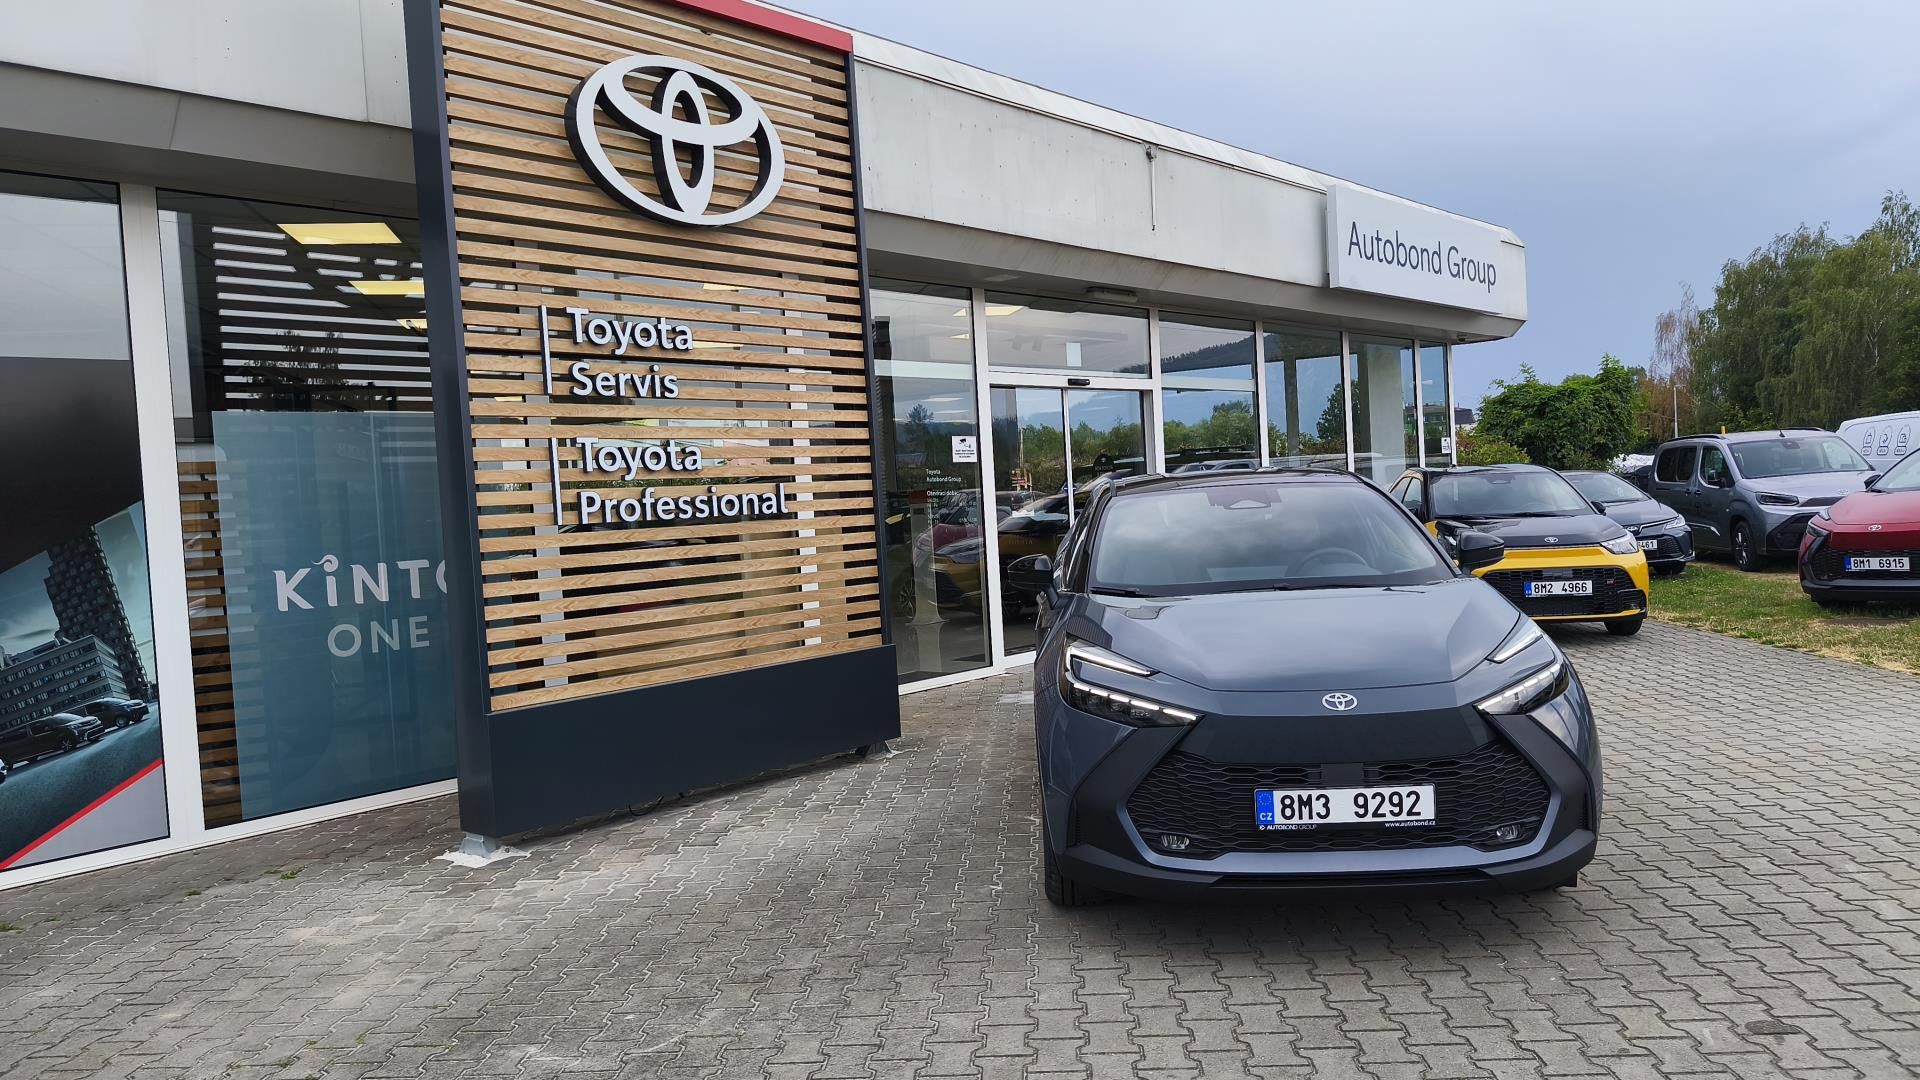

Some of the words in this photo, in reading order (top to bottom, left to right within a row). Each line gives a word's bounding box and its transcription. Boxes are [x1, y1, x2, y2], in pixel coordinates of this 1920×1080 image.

[1348, 221, 1442, 275] Autobond
[1447, 246, 1497, 293] Group
[565, 307, 694, 355] Toyota
[570, 362, 680, 398] Servis
[576, 437, 703, 480] Toyota
[578, 483, 790, 524] Professional
[1853, 558, 1871, 568] 8M1
[1878, 558, 1905, 568] 6915
[272, 554, 447, 611] KINT
[1533, 583, 1553, 593] 8M2
[1561, 582, 1588, 592] 4966
[327, 616, 430, 657] ONE
[1259, 812, 1273, 821] CZ
[1280, 793, 1331, 820] 8M3
[1353, 790, 1421, 818] 9292
[1385, 820, 1436, 828] www.autobond.cz
